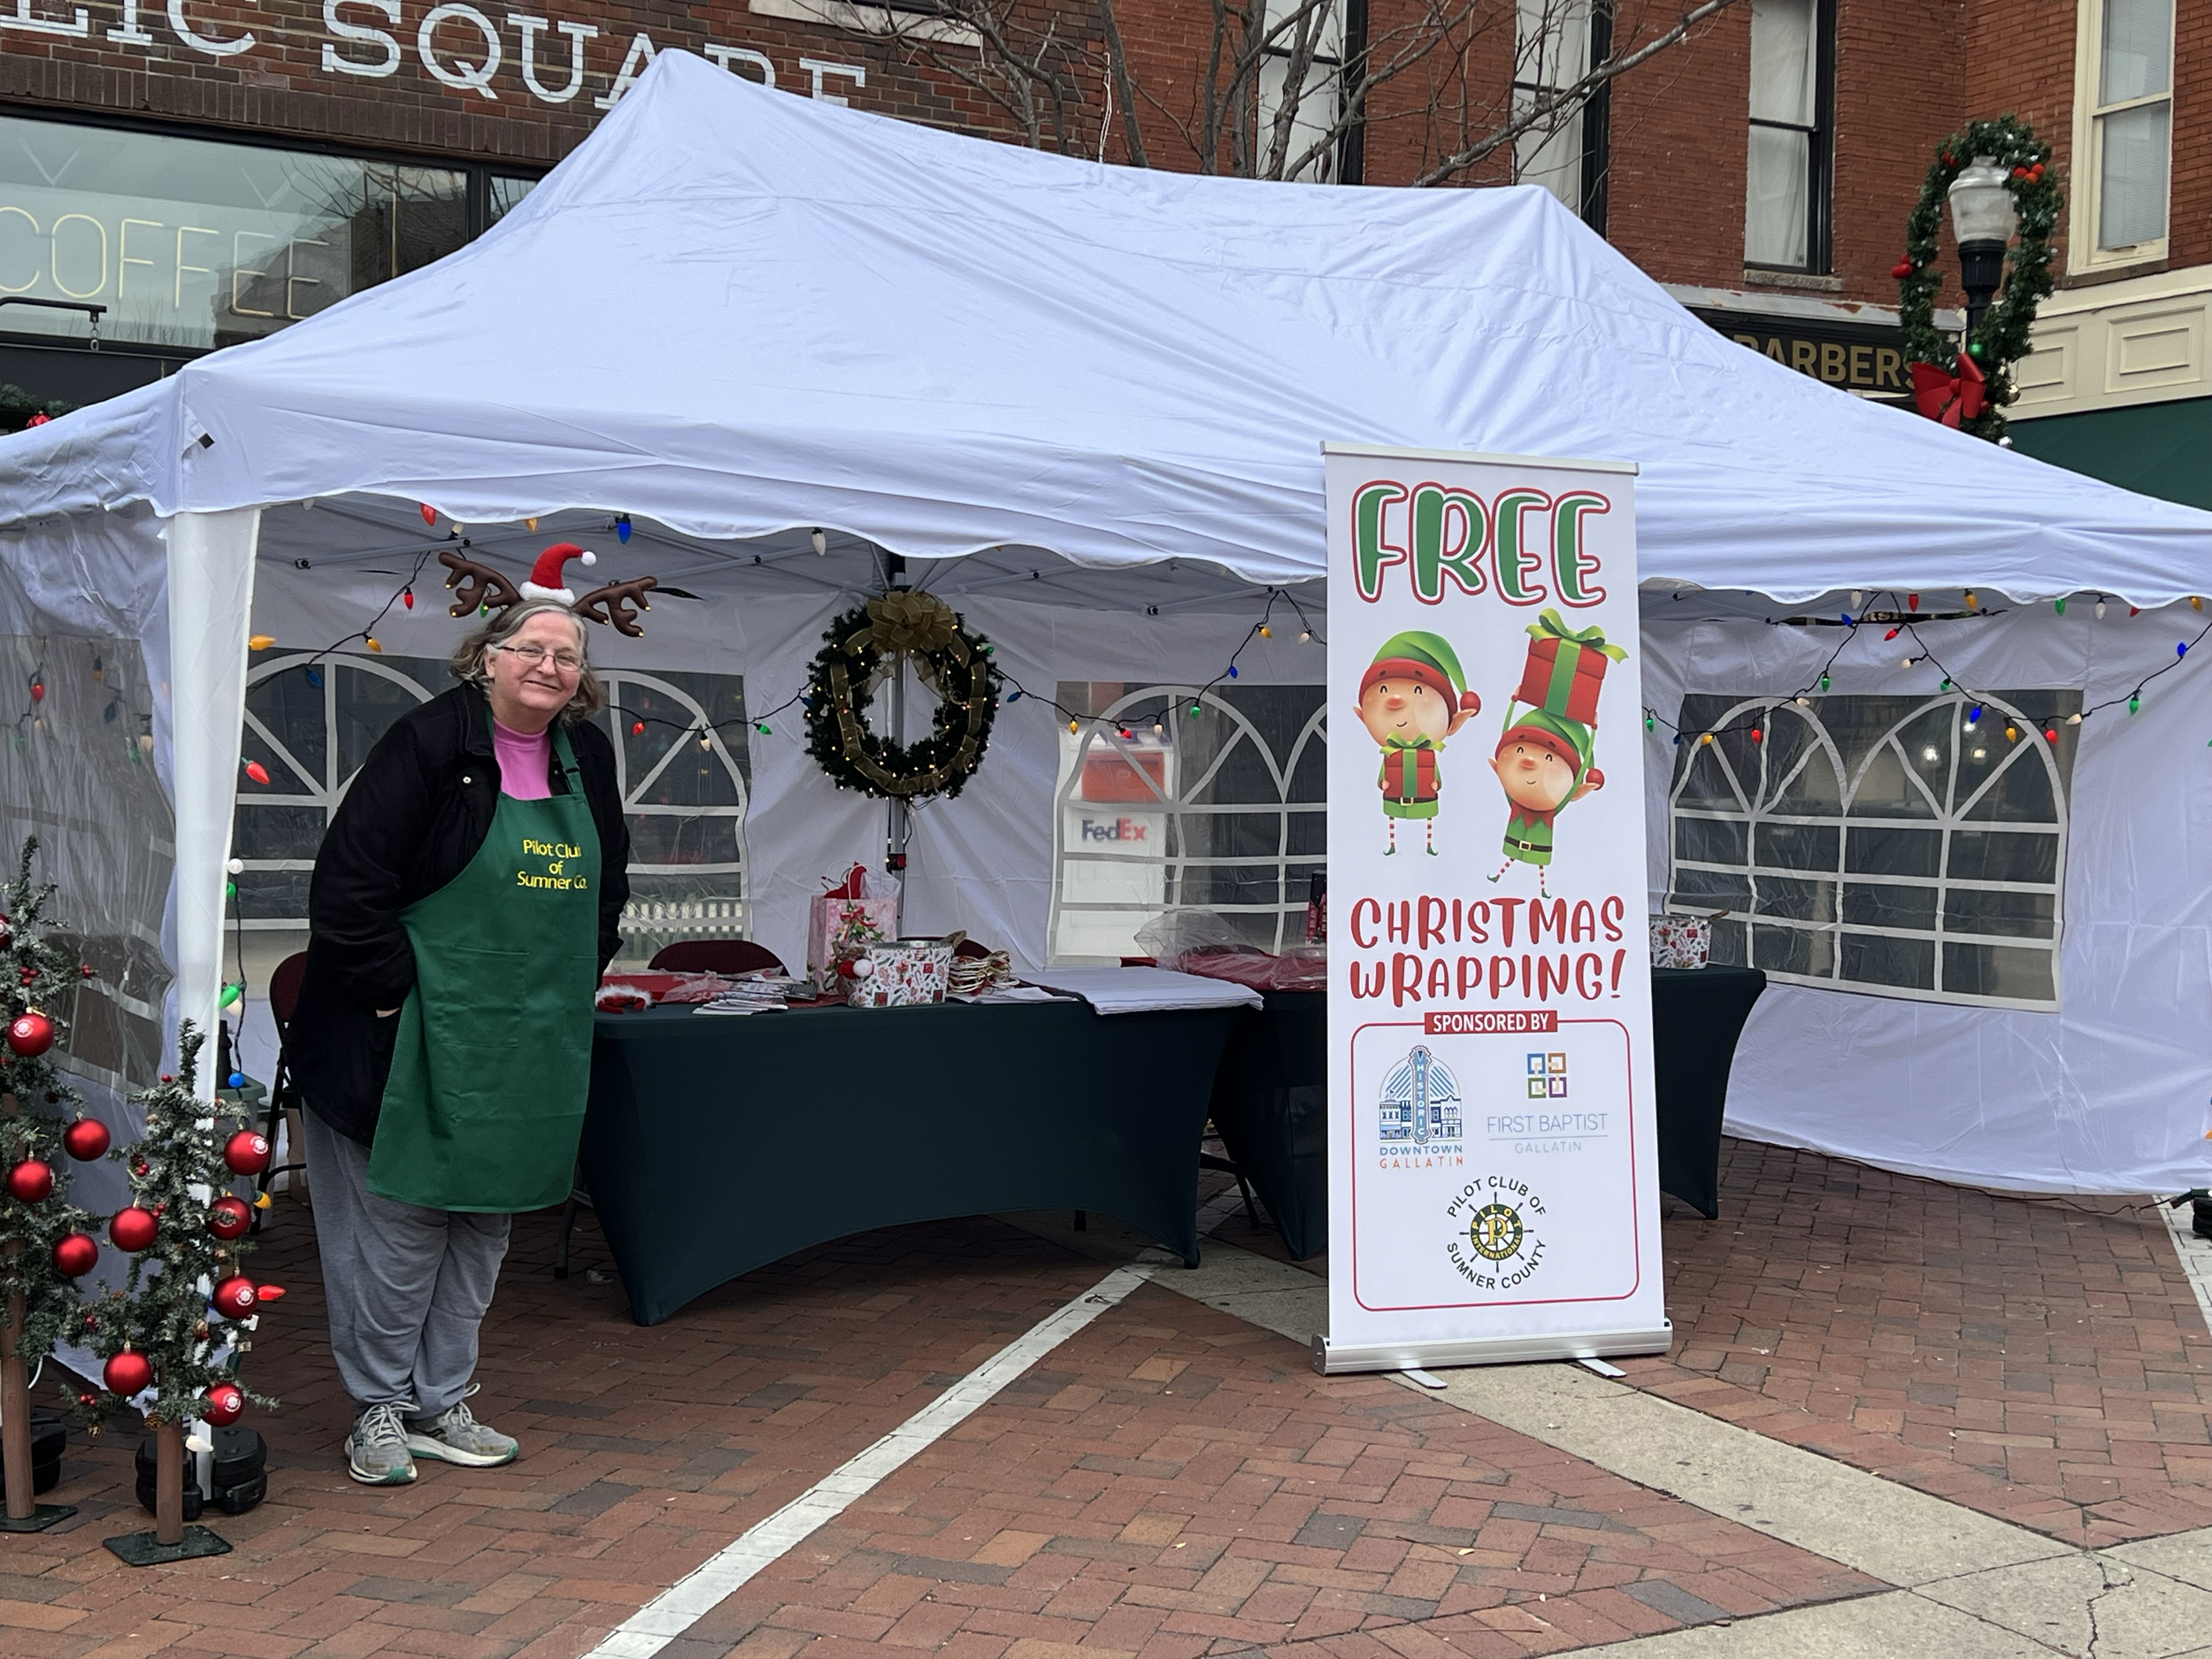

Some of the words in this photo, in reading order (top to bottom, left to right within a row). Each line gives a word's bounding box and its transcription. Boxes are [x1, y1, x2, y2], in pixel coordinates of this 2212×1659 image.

[0, 206, 330, 319] COFFEE
[1352, 480, 1611, 608] FREE
[1081, 818, 1148, 841] FedEx
[523, 839, 554, 856] Pilot
[549, 860, 564, 875] of
[517, 871, 572, 889] Sumner
[1350, 895, 1624, 949] CHRISTMAS
[1349, 949, 1627, 1008] WRAPPING!
[1432, 1013, 1526, 1033] SPONSORED
[1531, 1012, 1549, 1031] BY
[1417, 1064, 1425, 1135] HISTORIC
[1486, 1115, 1534, 1133] FIRST
[1540, 1113, 1609, 1133] BAPTIST
[1379, 1144, 1463, 1156] DOWNTOWN
[1514, 1141, 1581, 1154] GALLATIN
[1379, 1156, 1463, 1169] GALLATIN
[1447, 1179, 1481, 1217] PILOT
[1488, 1176, 1529, 1196] CLUB
[1530, 1196, 1547, 1216] OF
[1471, 1205, 1522, 1230] PILOT
[1471, 1234, 1522, 1259] INTERNATIONAL
[1447, 1242, 1495, 1289] SUMNER
[1502, 1239, 1546, 1288] COUNTY
